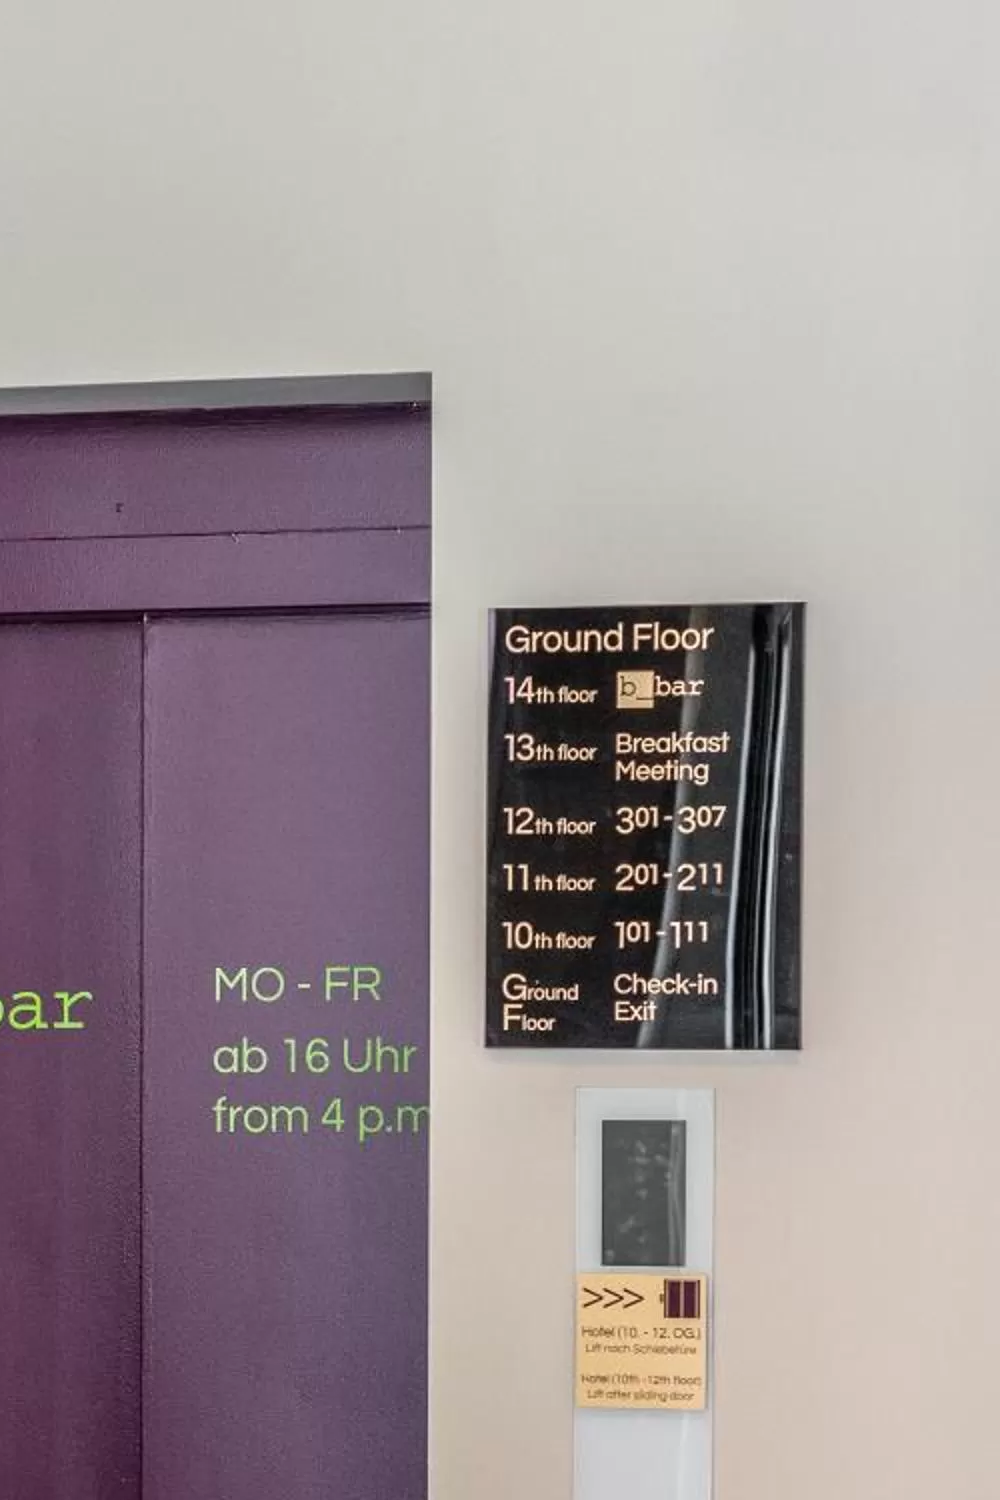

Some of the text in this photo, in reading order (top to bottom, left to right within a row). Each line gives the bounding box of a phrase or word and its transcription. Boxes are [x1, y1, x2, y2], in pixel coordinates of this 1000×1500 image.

[505, 622, 715, 653] Ground Floor
[504, 676, 598, 705] 14th floor
[504, 734, 598, 762] 13th floor
[615, 732, 730, 754] Breakfast
[615, 760, 709, 786] Meeting
[503, 807, 597, 835] 12th floor
[556, 875, 596, 892] floor
[502, 921, 596, 949] 10th floor
[215, 966, 285, 1001] MO
[324, 966, 381, 1001] FR
[502, 973, 579, 1001] Ground
[613, 973, 718, 995] Check-in
[503, 1004, 556, 1031] Floor
[614, 1001, 658, 1021] Exit
[213, 1036, 418, 1073] ab 16 Uhr
[212, 1096, 309, 1133] from
[321, 1097, 345, 1133] 4
[582, 1326, 614, 1338] Hotel
